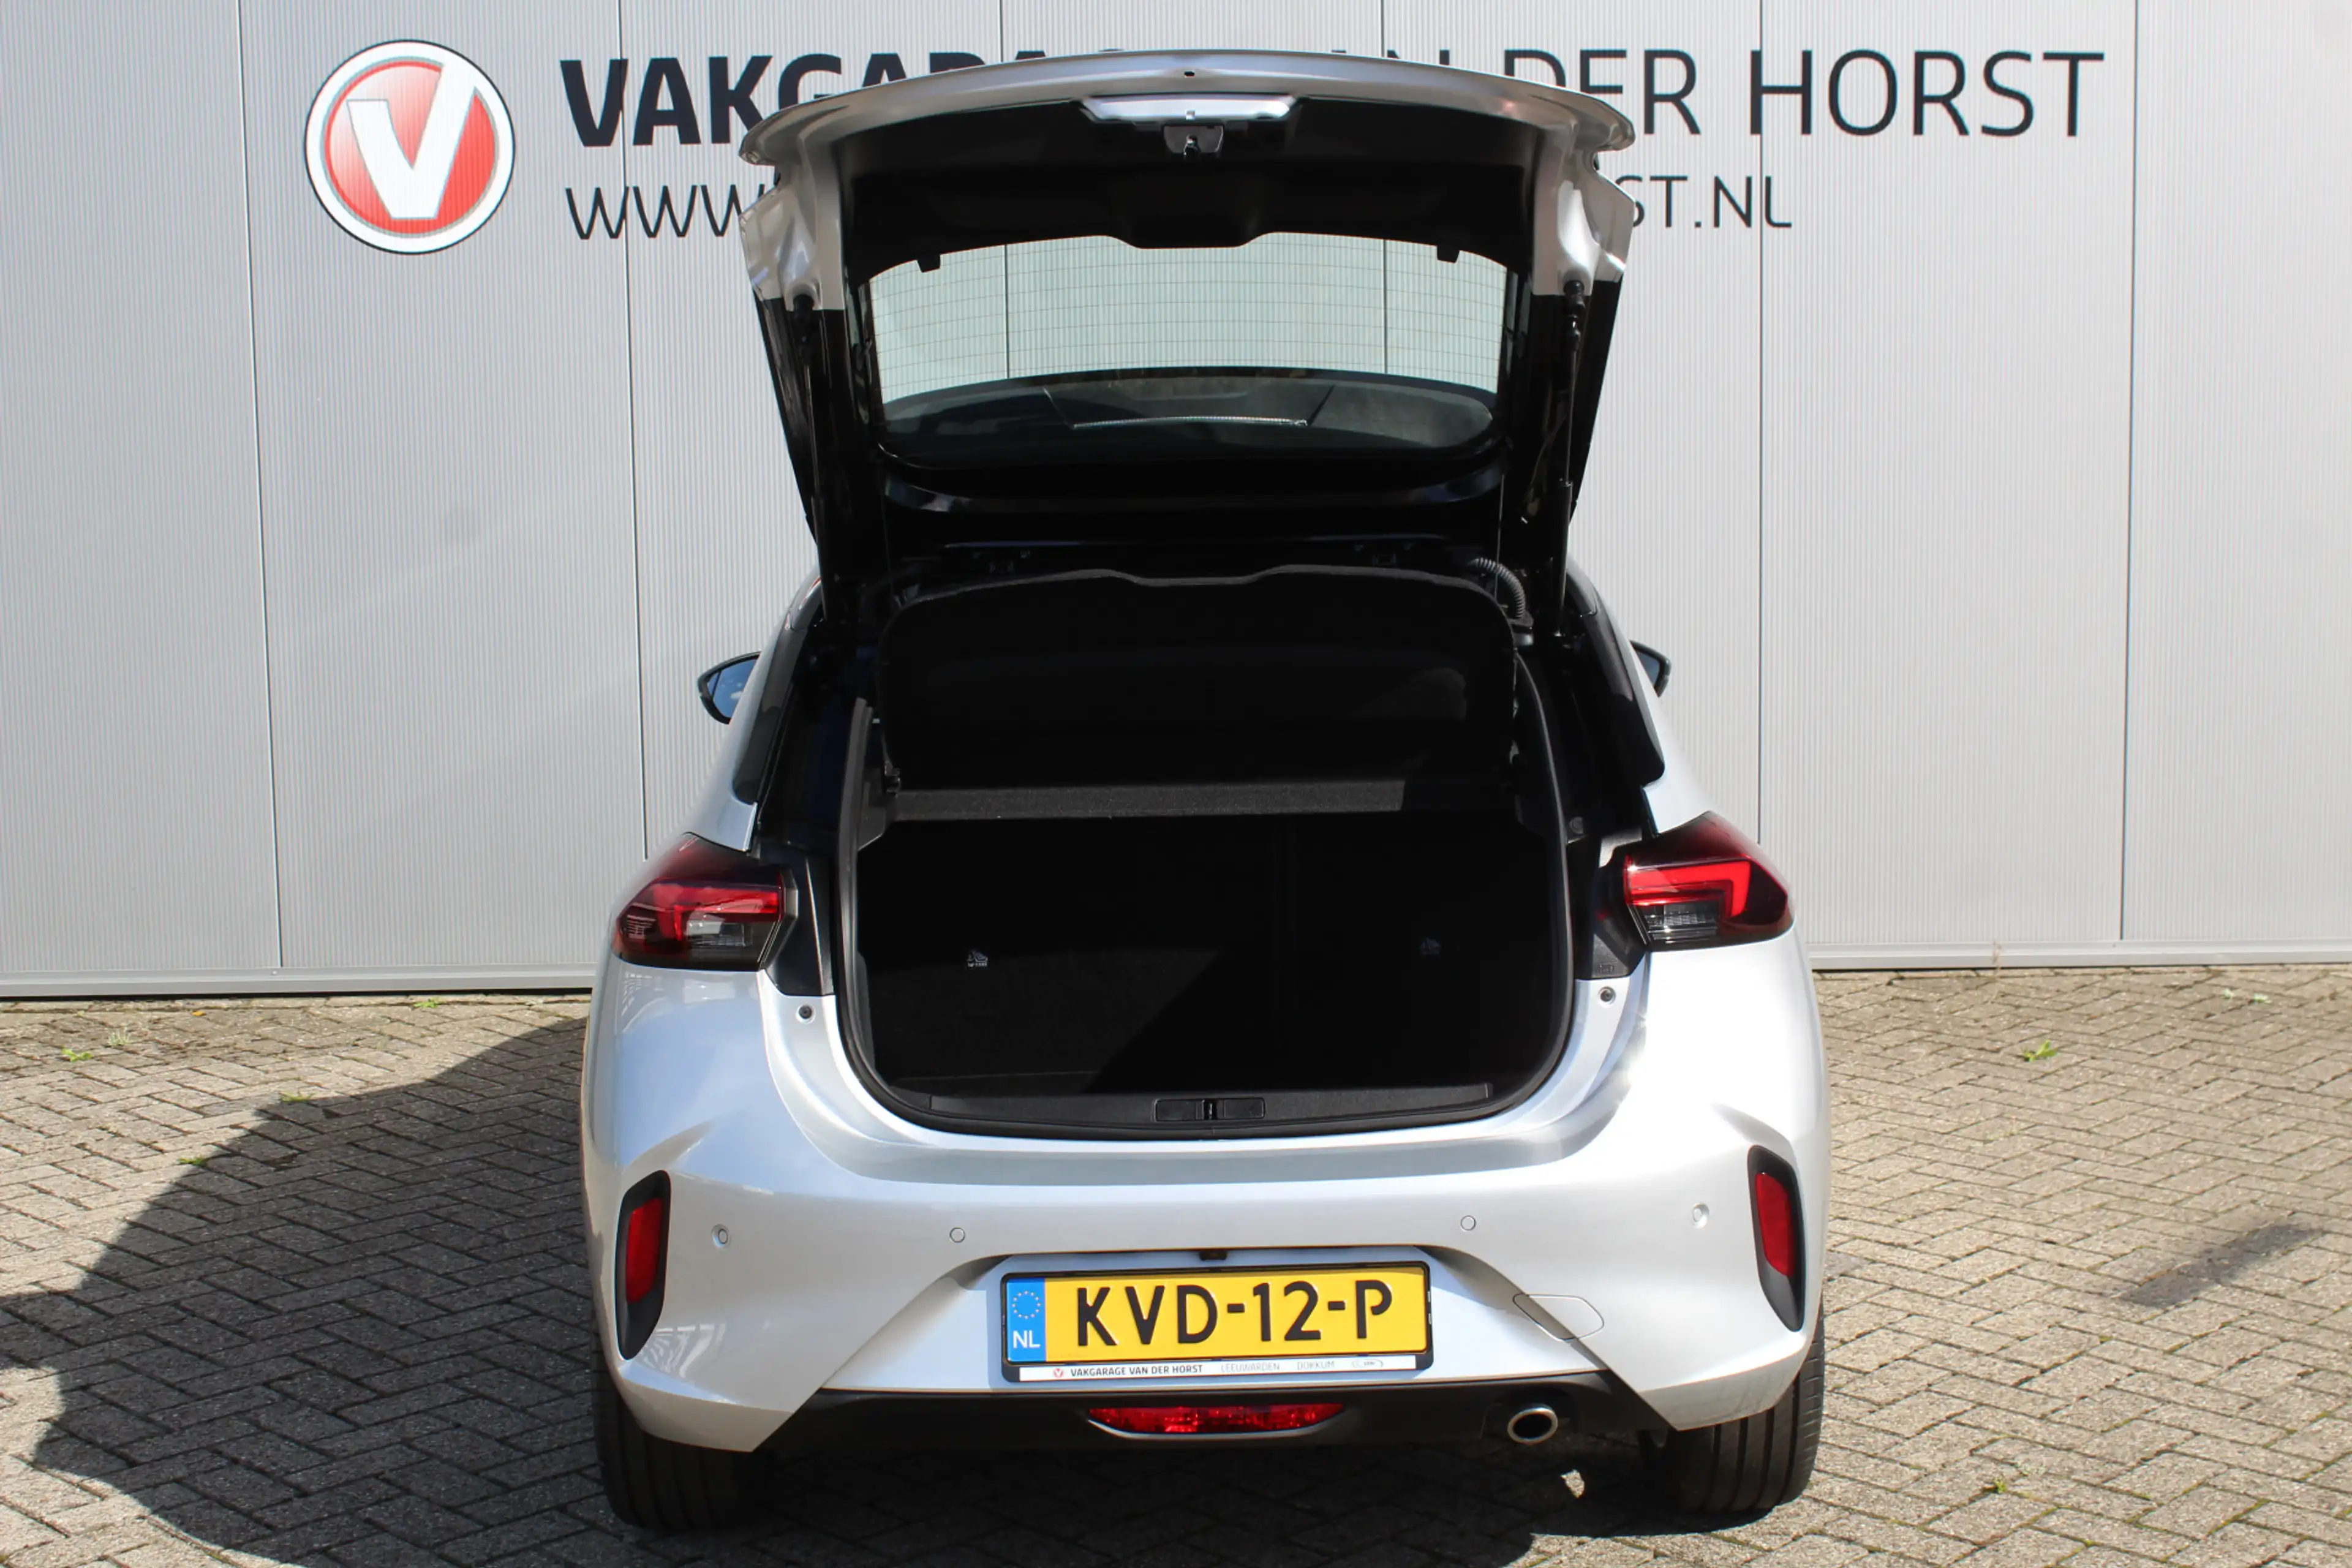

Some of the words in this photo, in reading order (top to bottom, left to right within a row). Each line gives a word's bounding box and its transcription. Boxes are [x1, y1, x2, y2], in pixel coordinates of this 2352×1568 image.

[1750, 50, 2105, 137] HORST
[1077, 1280, 1392, 1346] KVD-12-P
[1013, 1330, 1041, 1349] NL
[1070, 1366, 1126, 1377] VAKGARAGE
[1129, 1366, 1148, 1375] VAN
[1152, 1365, 1170, 1374] DER
[1172, 1364, 1203, 1373] HORST
[1221, 1362, 1280, 1373] LEEUWARDEN
